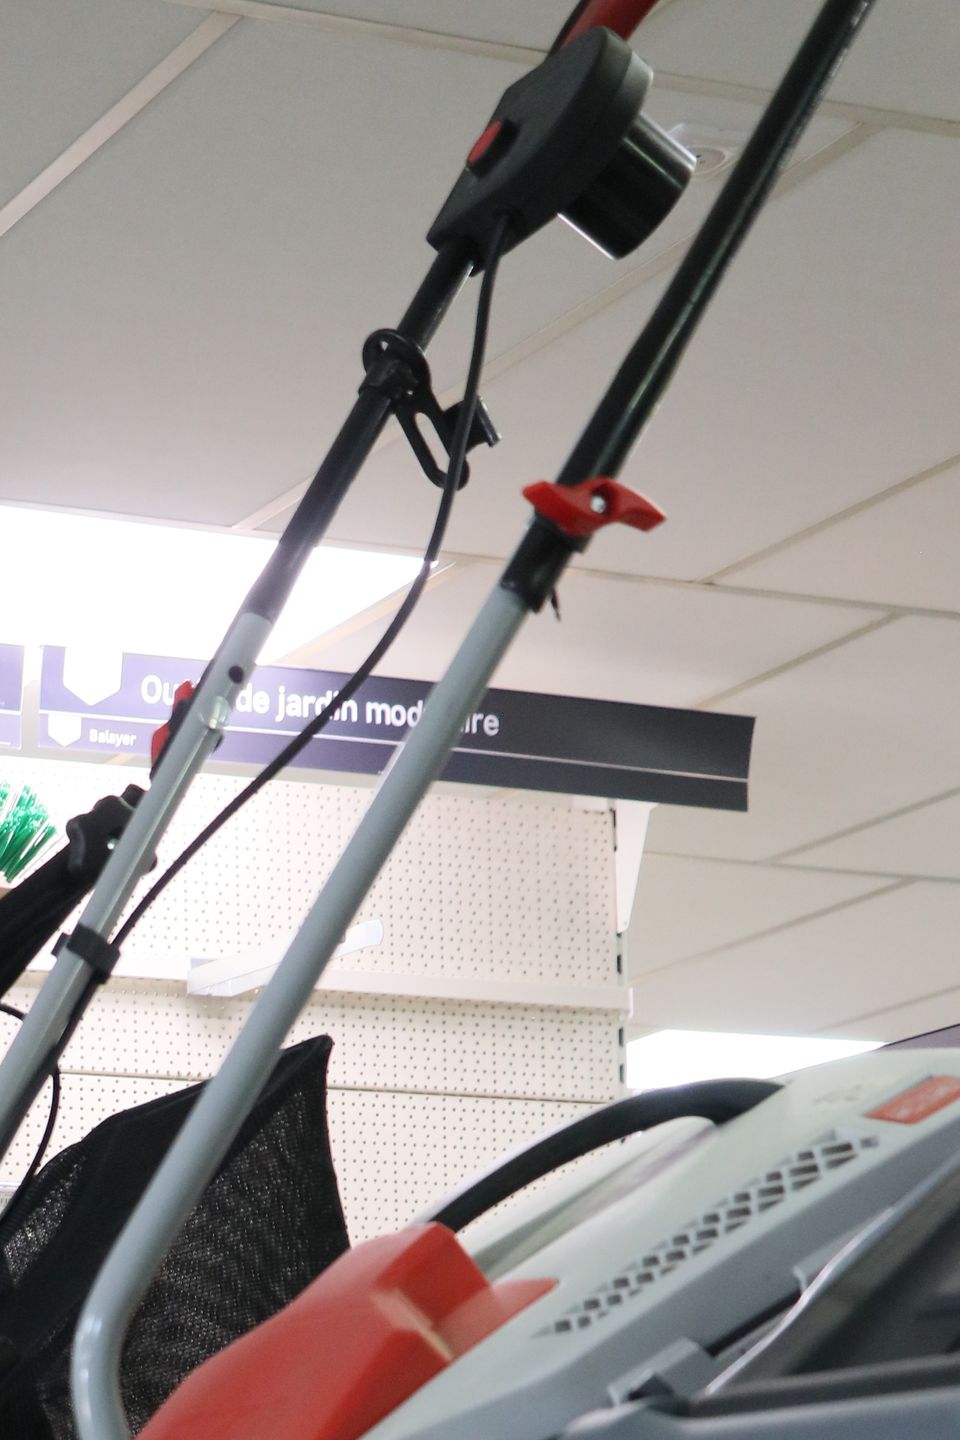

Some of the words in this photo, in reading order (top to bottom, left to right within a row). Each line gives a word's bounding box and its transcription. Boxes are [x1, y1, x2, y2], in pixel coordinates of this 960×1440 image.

[235, 682, 271, 714] de
[274, 685, 359, 722] jardin
[365, 699, 500, 737] modire
[89, 728, 137, 748] Balayer
